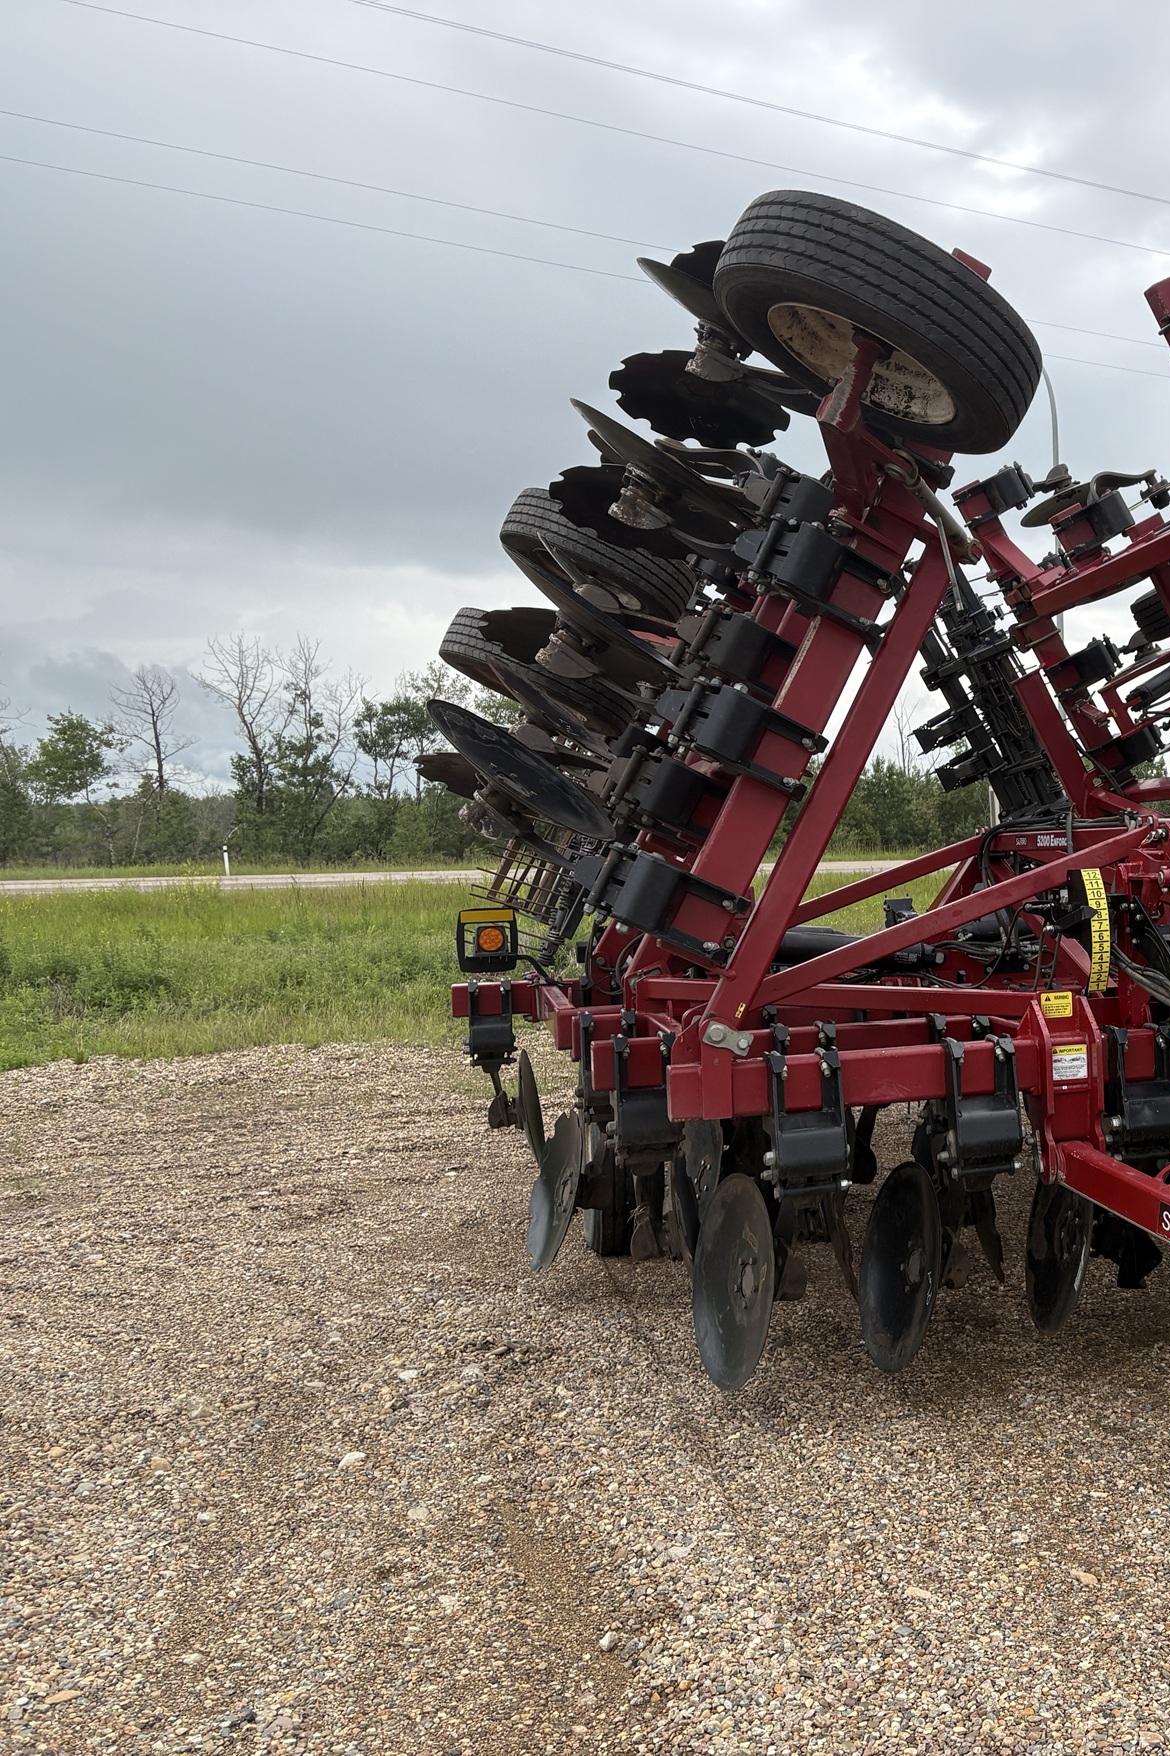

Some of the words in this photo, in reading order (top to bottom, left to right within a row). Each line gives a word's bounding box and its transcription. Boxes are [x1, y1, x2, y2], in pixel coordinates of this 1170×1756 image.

[1086, 871, 1097, 879] 12
[1088, 880, 1100, 888] 11
[1090, 890, 1102, 898] 10
[1094, 900, 1101, 908] 9
[1096, 911, 1103, 919] 8
[1097, 921, 1103, 930] 7
[1098, 932, 1104, 941] 6
[1098, 943, 1105, 951] 5
[1097, 953, 1104, 962] 4
[1097, 964, 1103, 972] 3
[1096, 973, 1102, 981] 2
